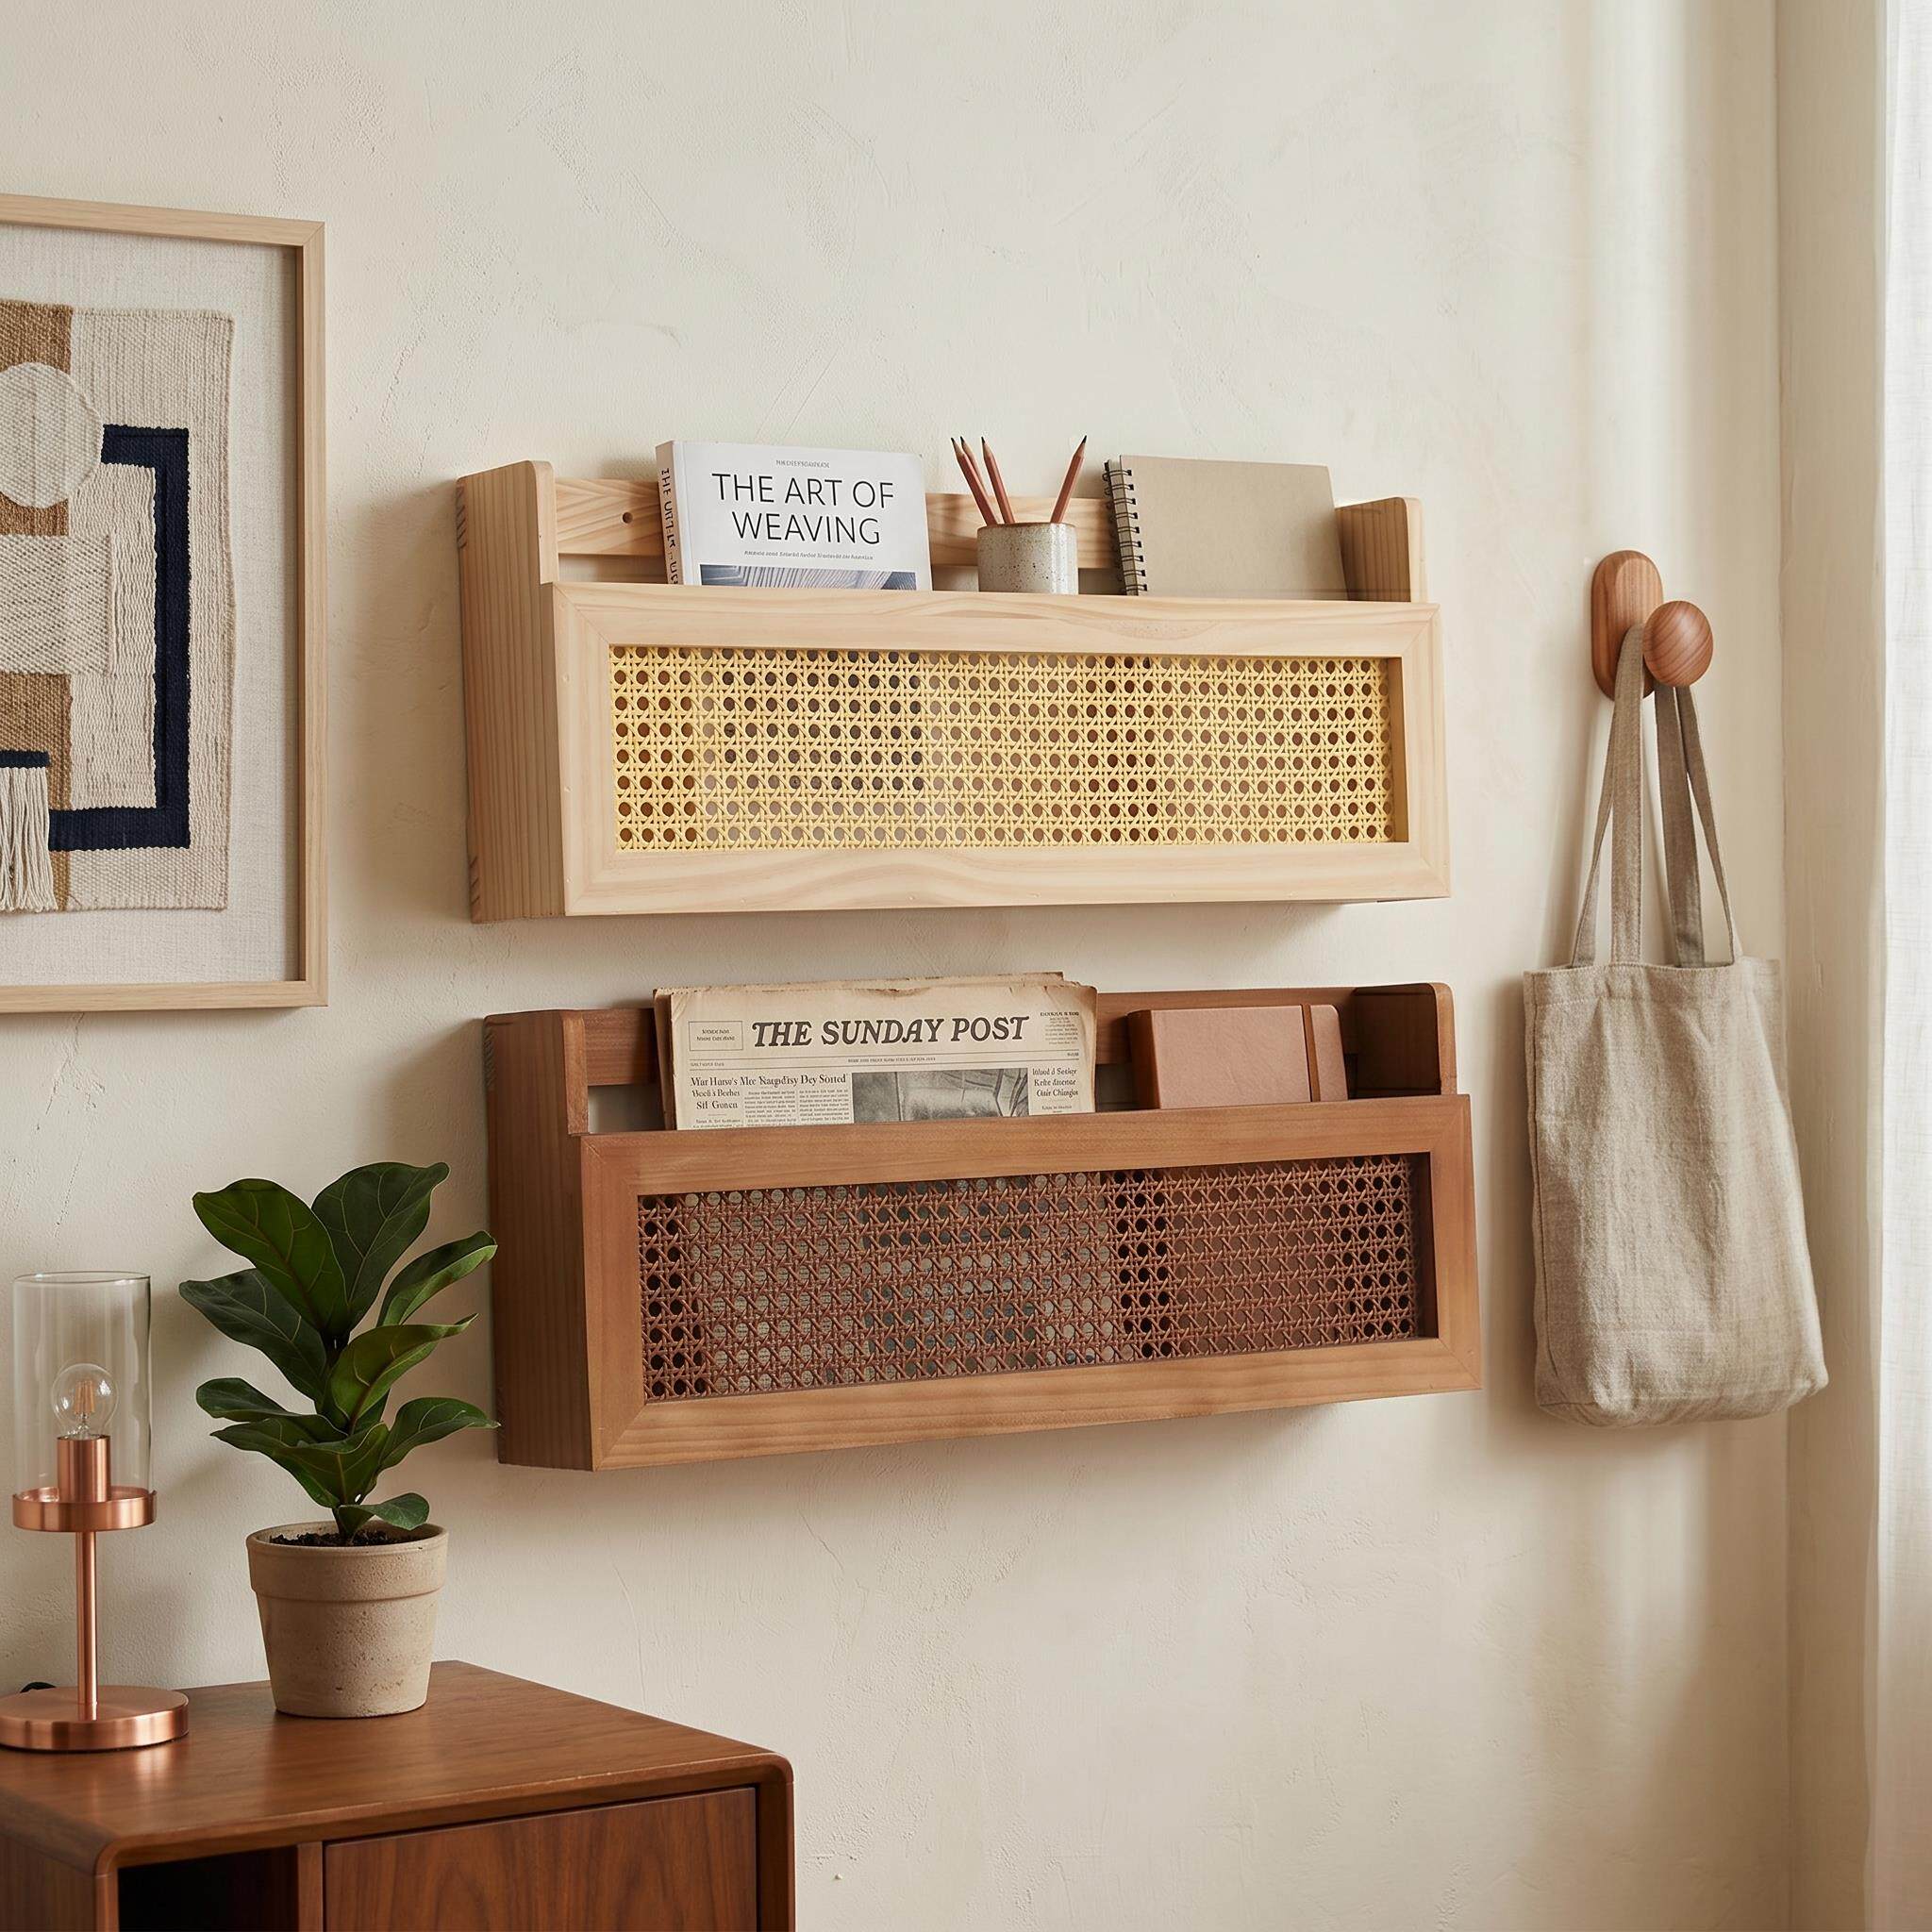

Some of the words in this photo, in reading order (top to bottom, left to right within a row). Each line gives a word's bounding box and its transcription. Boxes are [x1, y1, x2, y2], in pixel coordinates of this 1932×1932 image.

[711, 473, 774, 503] THE
[785, 476, 842, 507] ART
[853, 480, 894, 509] OF
[732, 510, 881, 544] WEAVING
[752, 1020, 813, 1048] THE
[821, 1018, 944, 1046] SUNDAY
[951, 1016, 1030, 1042] POST
